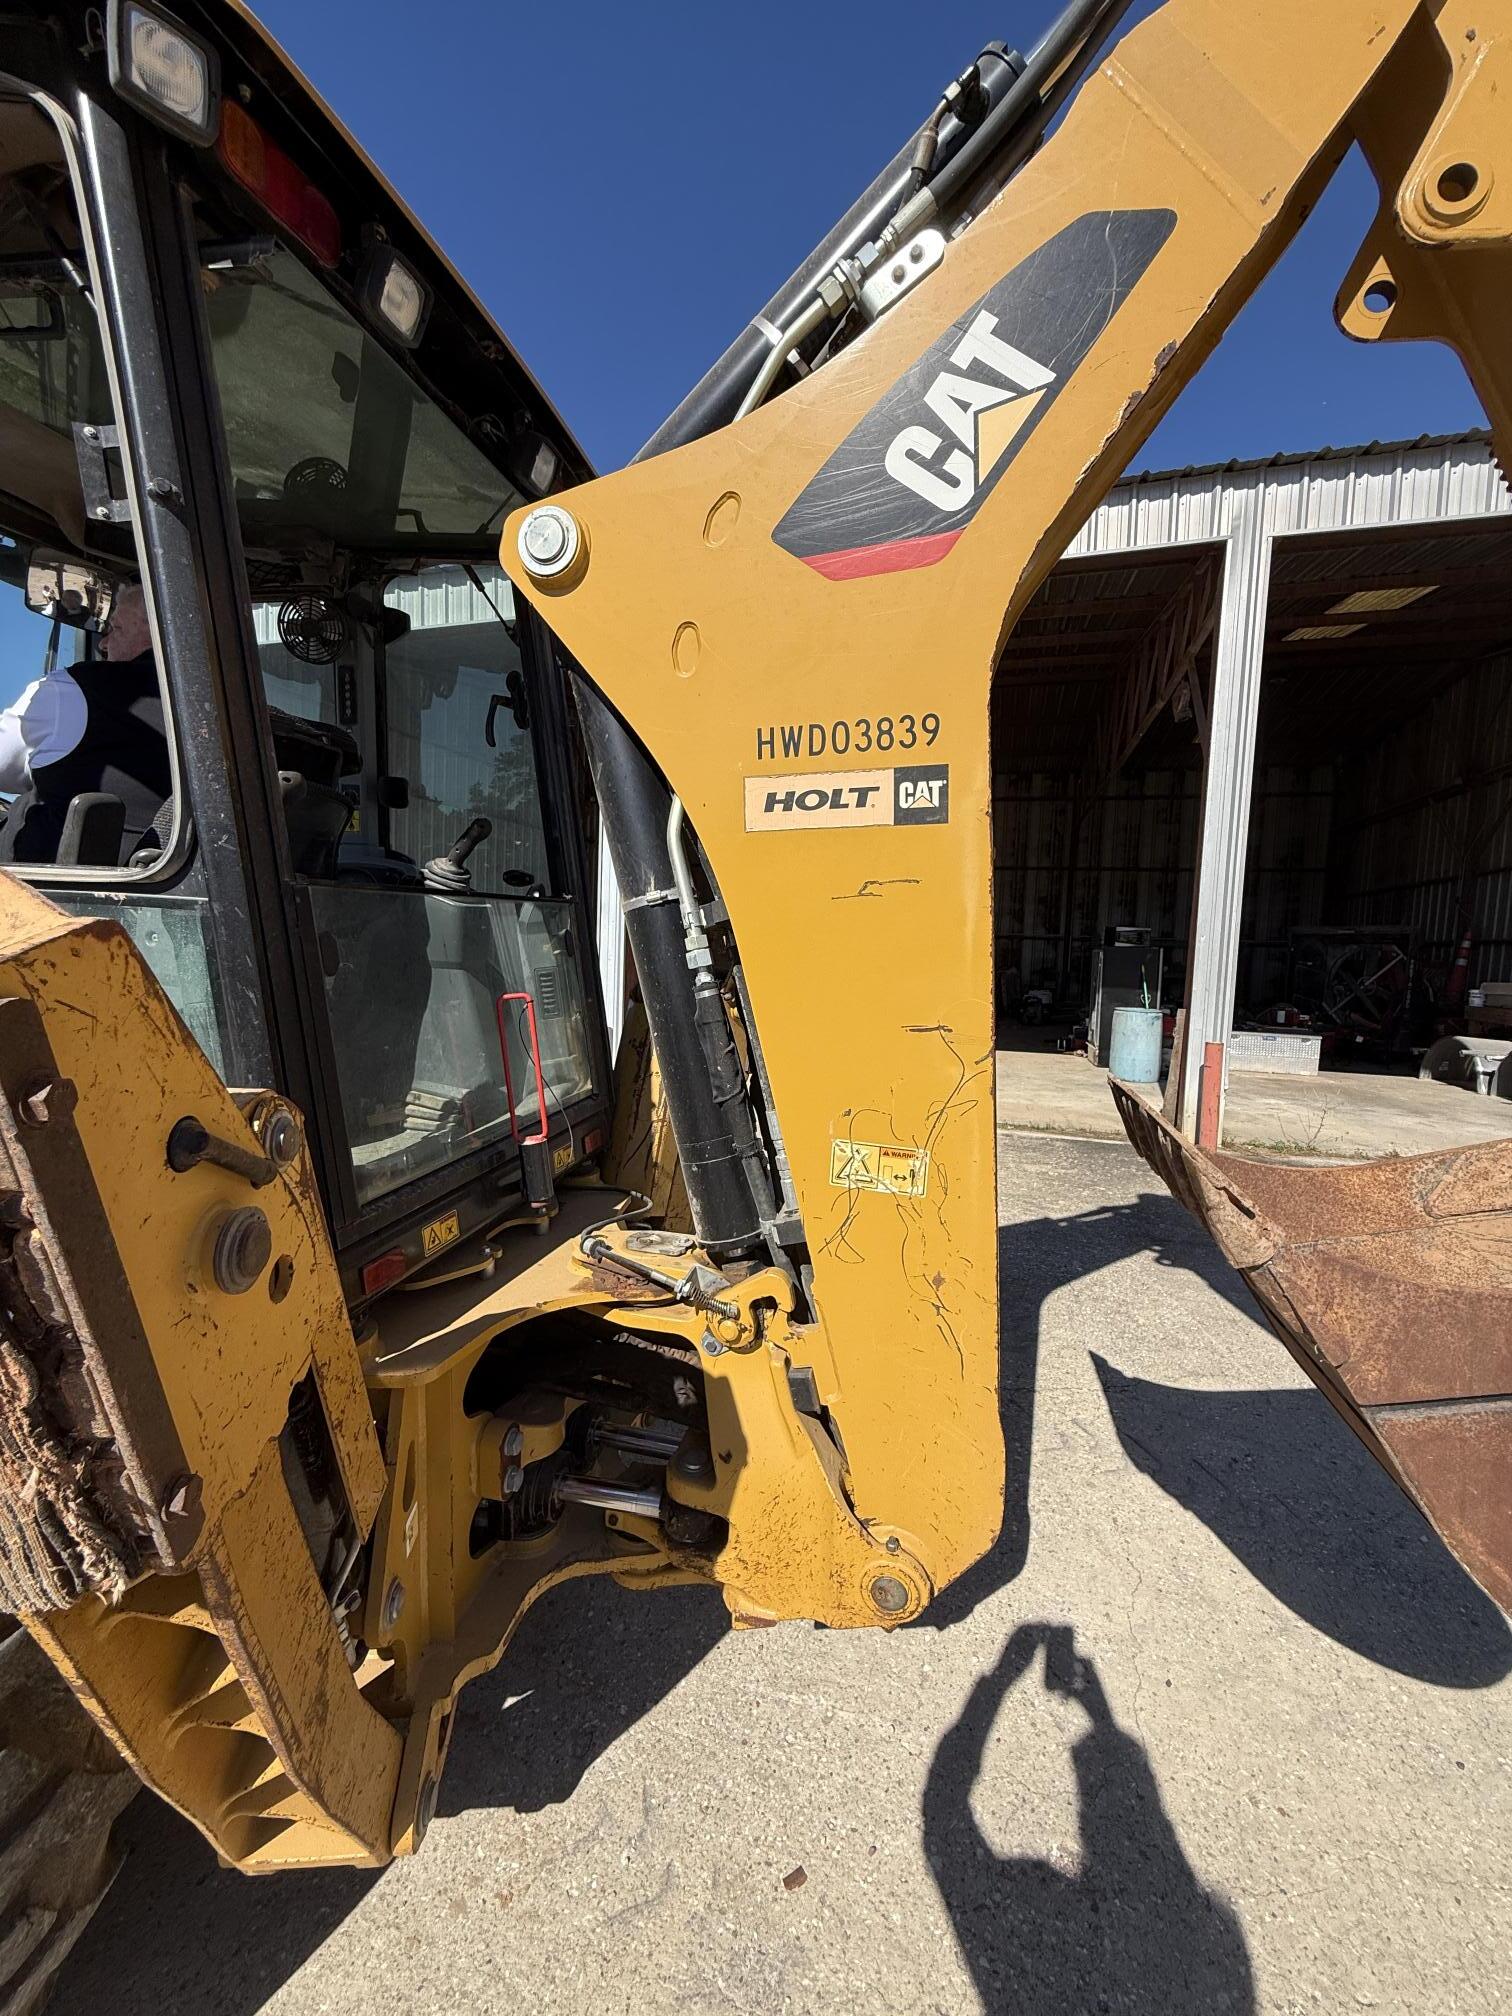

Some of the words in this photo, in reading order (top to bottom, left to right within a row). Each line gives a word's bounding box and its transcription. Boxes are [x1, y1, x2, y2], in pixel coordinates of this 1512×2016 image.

[885, 309, 1057, 512] CAT
[757, 713, 941, 760] HWD03839
[764, 786, 881, 813] HOLT
[899, 780, 943, 809] CAT
